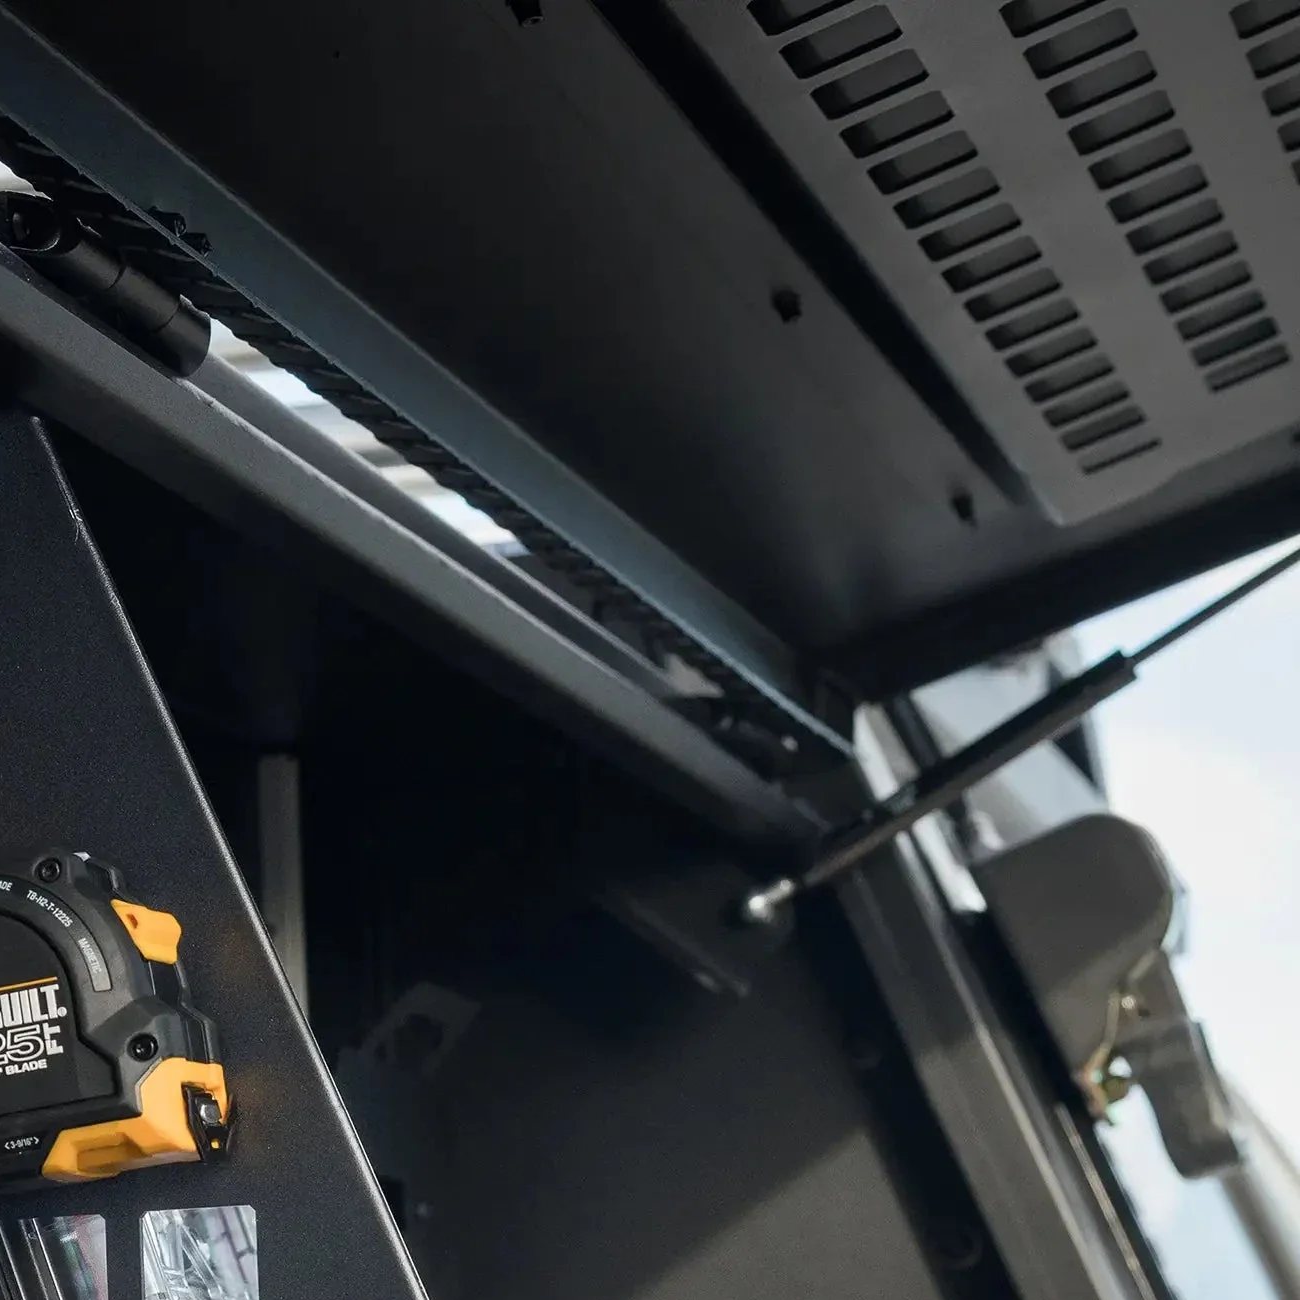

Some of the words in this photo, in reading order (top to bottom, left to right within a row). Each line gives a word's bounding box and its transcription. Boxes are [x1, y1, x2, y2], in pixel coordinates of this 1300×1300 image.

[26, 889, 73, 928] TB-H2-T-12225
[78, 937, 102, 974] MAGNETIC
[42, 1023, 64, 1056] FT
[5, 1058, 48, 1076] BLADE
